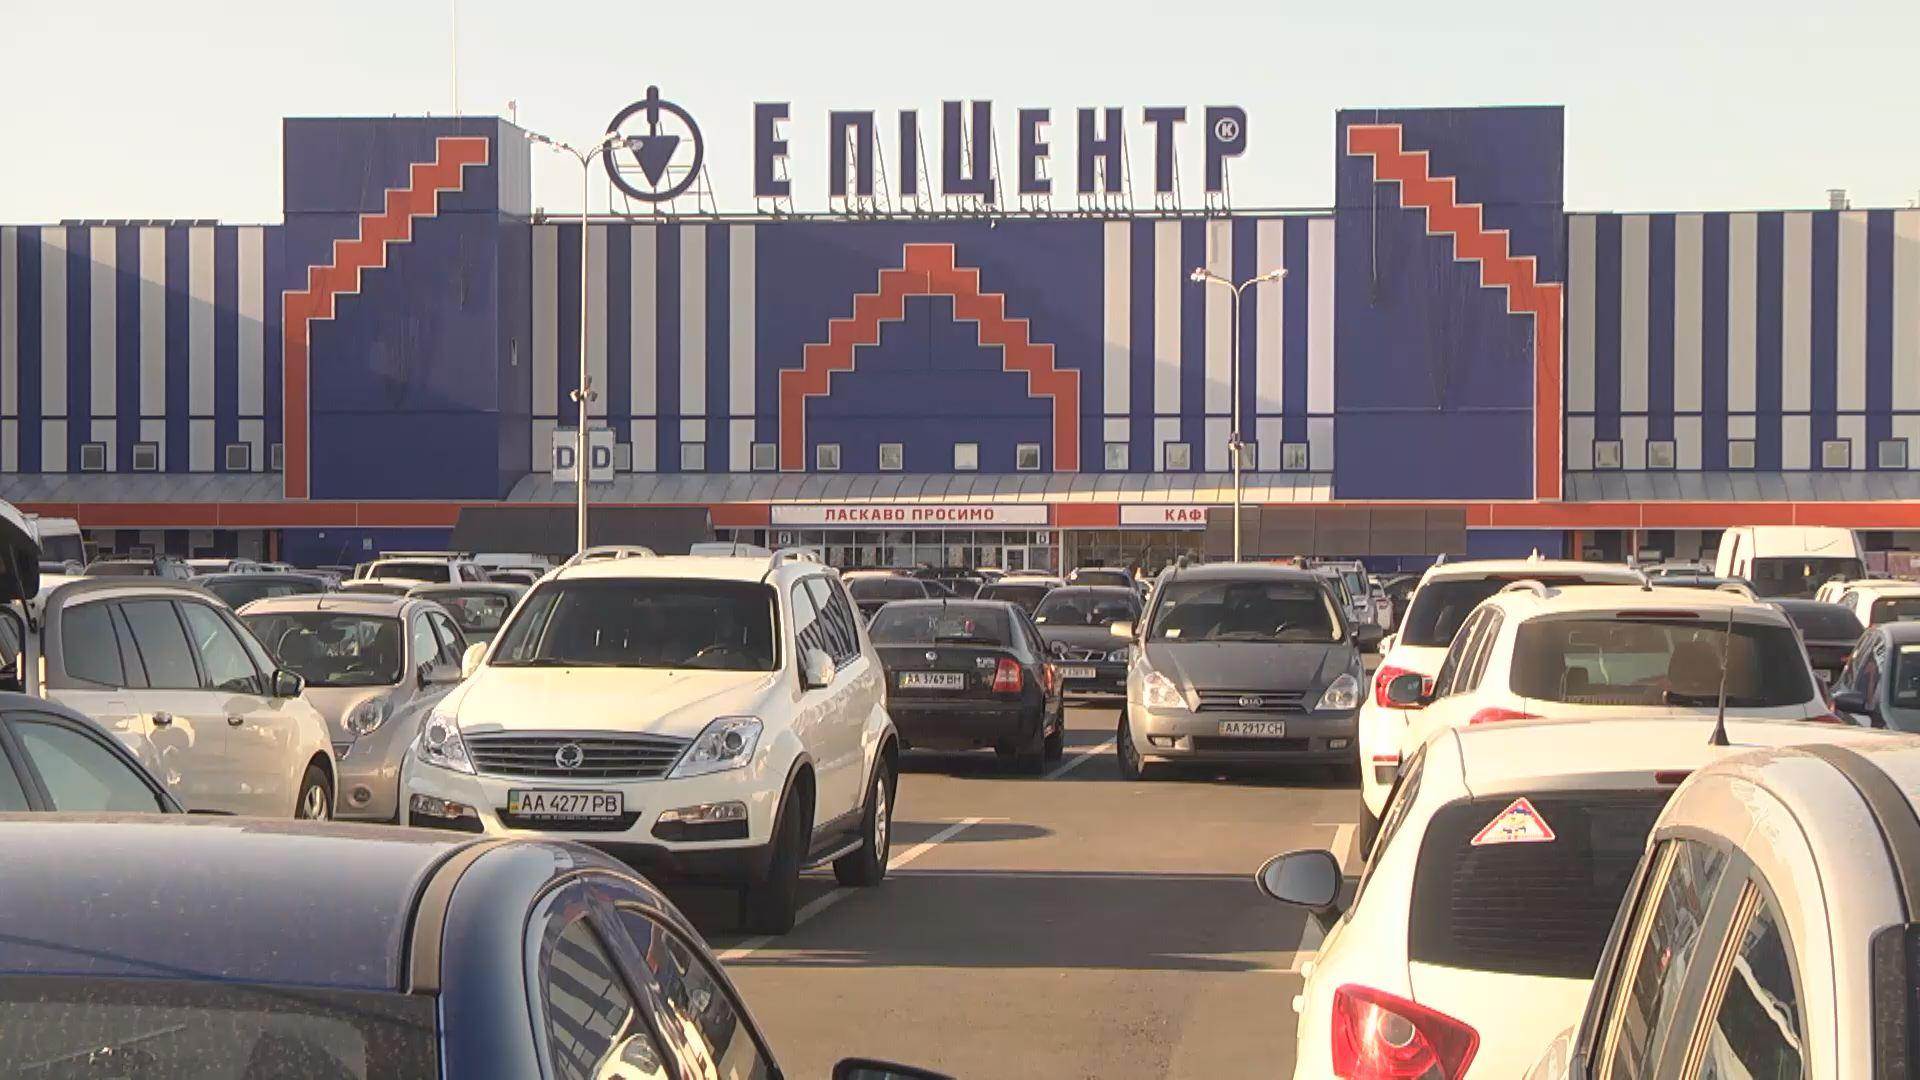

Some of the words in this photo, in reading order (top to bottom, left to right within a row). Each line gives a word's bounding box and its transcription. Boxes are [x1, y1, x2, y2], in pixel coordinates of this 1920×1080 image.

[754, 100, 1247, 204] ЕПІЦЕНТР
[556, 446, 575, 469] D
[592, 446, 610, 468] D
[825, 508, 905, 520] ЛАСКАВО
[911, 508, 994, 520] ПРОСИМО
[1225, 723, 1240, 733] AA
[521, 794, 545, 811] AA
[550, 795, 588, 812] 4277
[592, 795, 617, 812] PB
